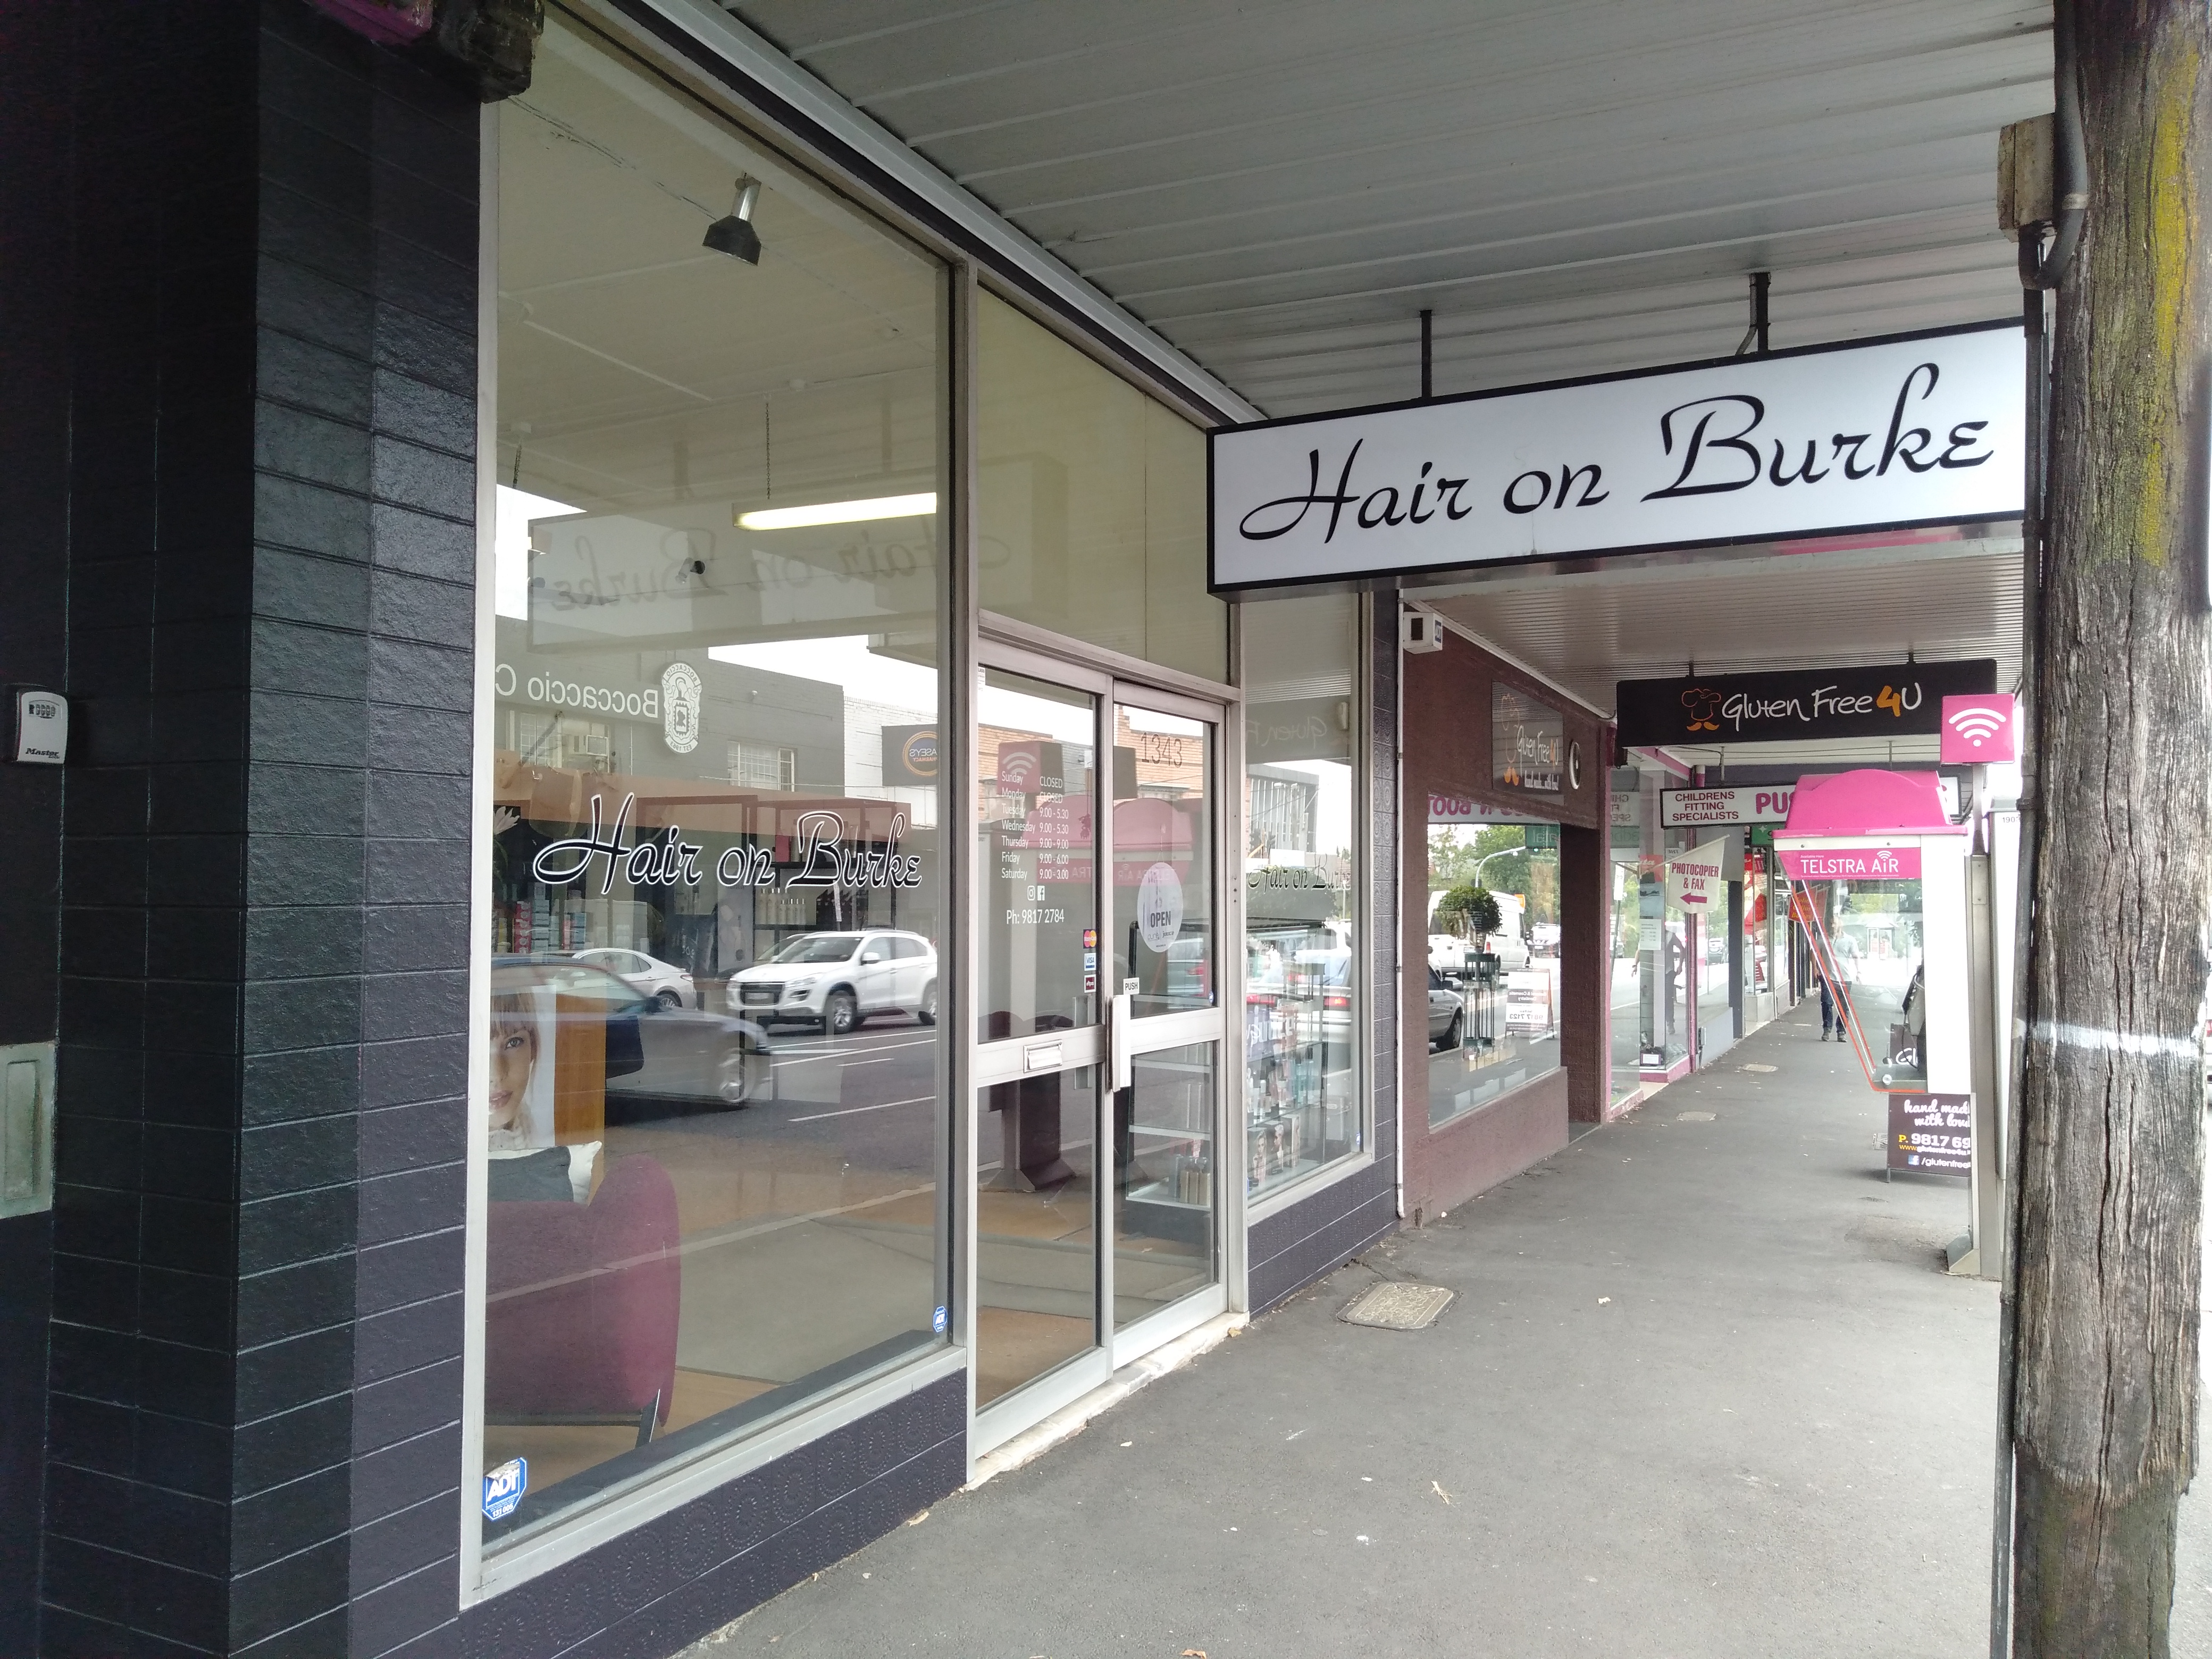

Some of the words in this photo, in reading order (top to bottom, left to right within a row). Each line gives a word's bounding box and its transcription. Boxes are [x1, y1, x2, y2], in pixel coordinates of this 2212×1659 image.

[1239, 438, 1473, 543] Hair
[1504, 463, 1609, 514] on
[1641, 362, 1994, 502] Burke
[1722, 693, 1811, 732] Gluten
[26, 748, 59, 756] Master
[1140, 732, 1183, 768] 1343
[1002, 771, 1023, 785] Sunday
[1040, 776, 1063, 789] CLOSED
[1002, 787, 1026, 802] Monday
[1040, 791, 1063, 804] CLOSED
[1675, 791, 1735, 802] CHILDRENS
[1755, 792, 1795, 814] PU
[1002, 803, 1026, 818] Tuesday
[1040, 807, 1052, 818] 9.00
[1057, 809, 1069, 819] 5.30
[1685, 802, 1724, 811] FITTING
[1672, 811, 1739, 822] SPECIALISTS
[1002, 819, 1036, 833] Wednesday
[1040, 822, 1052, 833] 9.00
[1057, 824, 1069, 834] 5.30
[532, 791, 704, 894] Hair
[717, 846, 776, 886] on
[786, 809, 923, 888] Burke
[1002, 835, 1029, 849] Thursday
[1040, 838, 1052, 849] 9.00
[1057, 839, 1069, 849] 9.00
[1002, 852, 1020, 865] Friday
[1040, 853, 1052, 864] 9.00
[1057, 854, 1069, 865] 6.00
[1800, 858, 1866, 874] TELSTRA
[1001, 868, 1027, 882] Saturday
[1040, 869, 1052, 879] 9.00
[1057, 869, 1069, 879] 3.00
[1248, 843, 1289, 894] Hair
[1293, 869, 1309, 890] on
[1311, 849, 1352, 891] Burke
[1671, 862, 1720, 877] PHOTOCOPIER
[1683, 877, 1689, 889] &
[1691, 878, 1705, 891] FAX
[1007, 910, 1020, 925] Ph:
[1021, 909, 1043, 924] 9817
[1044, 908, 1065, 923] 2784
[1150, 911, 1171, 928] OPEN
[1125, 981, 1138, 991] PUSH
[1904, 1099, 1938, 1113] hand
[1940, 1101, 1970, 1115] mad
[1914, 1112, 1944, 1126] with
[1898, 1134, 1908, 1143] P.
[1911, 1133, 1950, 1147] 9817
[487, 1468, 520, 1502] ADT
[492, 1509, 502, 1518] 131
[502, 1503, 514, 1513] 005
